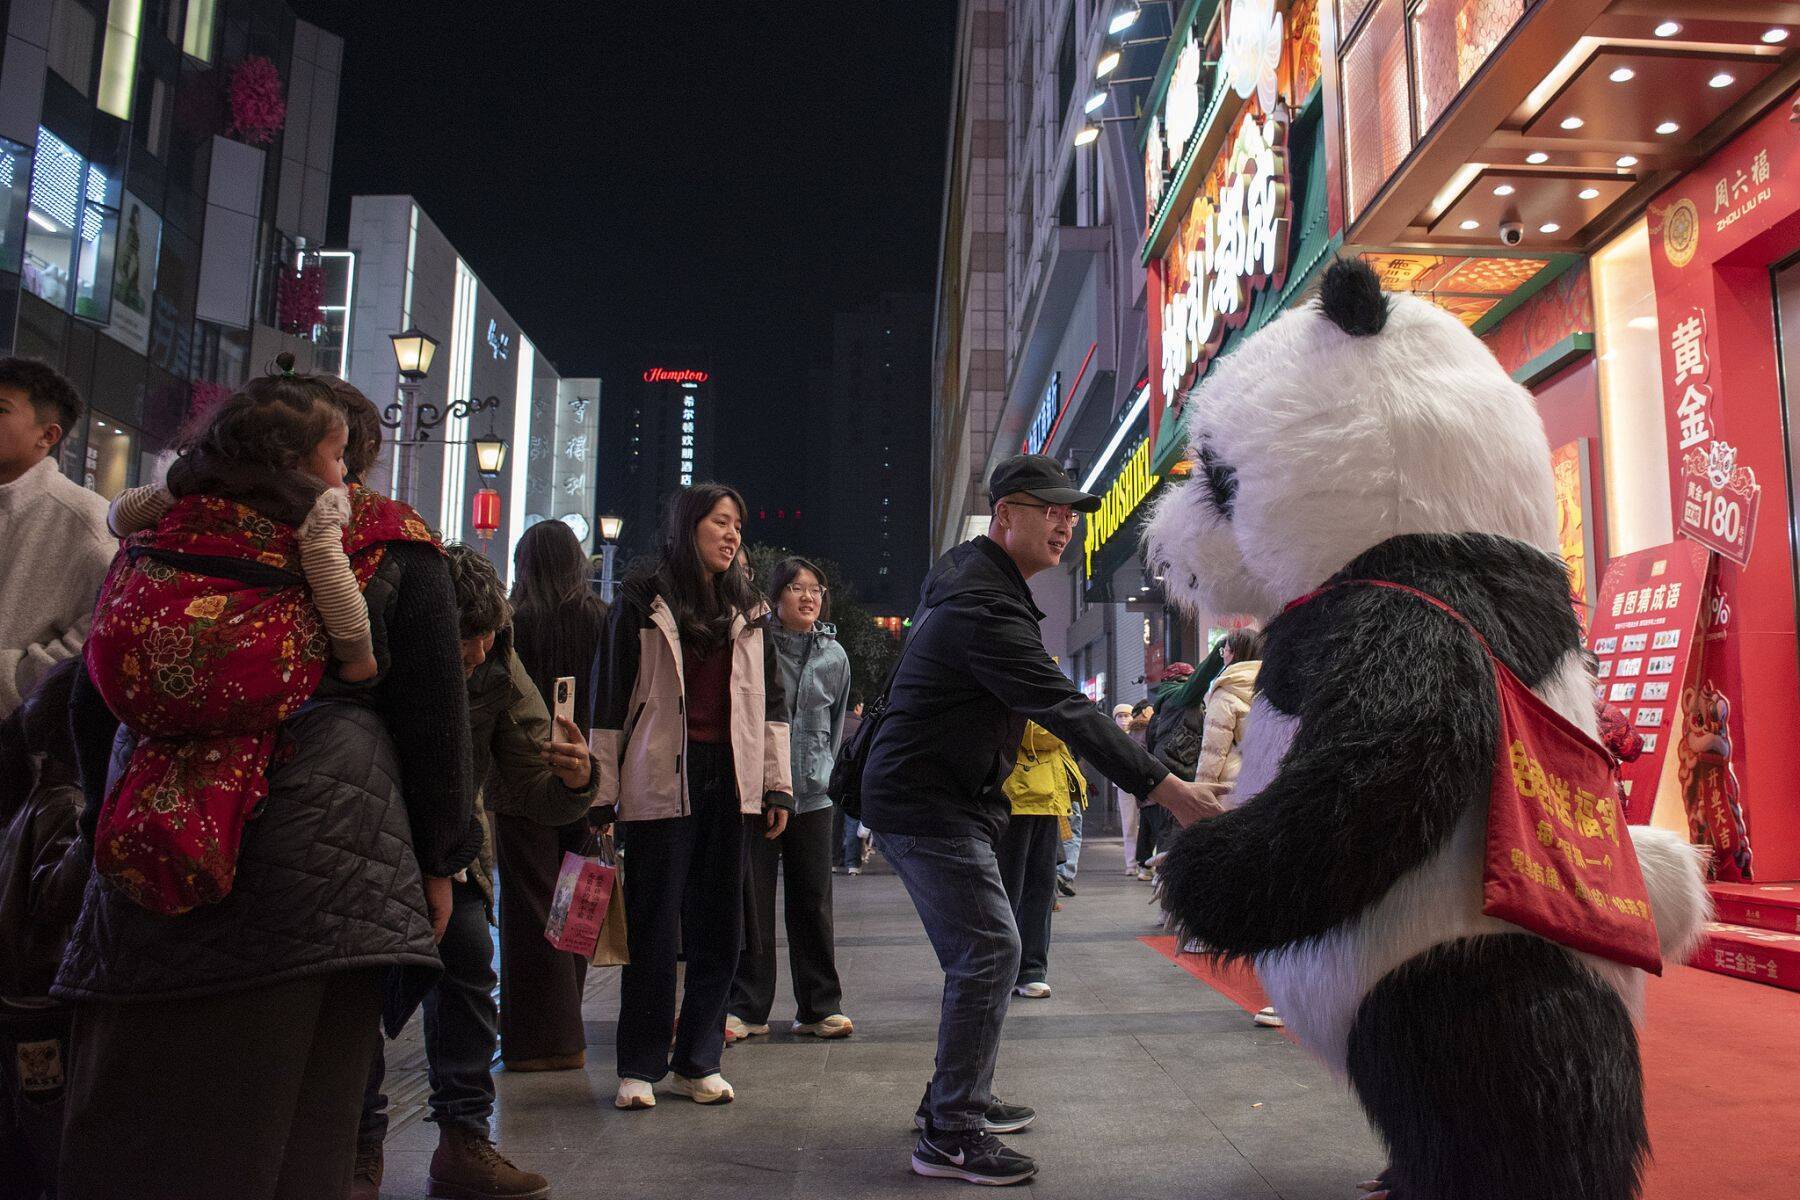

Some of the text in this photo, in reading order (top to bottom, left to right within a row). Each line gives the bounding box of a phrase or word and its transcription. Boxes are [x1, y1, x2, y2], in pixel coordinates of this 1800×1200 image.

[1714, 149, 1770, 214] 周六福
[1715, 187, 1772, 233] ZHOU LIU FU
[644, 367, 708, 382] Hampton
[1672, 316, 1709, 450] 黄金
[681, 395, 695, 487] 希尔顿欢朋酒店
[1687, 481, 1703, 503] 黄金
[1703, 490, 1740, 543] 180
[1611, 583, 1682, 616] 看图猜成语
[1707, 769, 1731, 849] 开业大吉
[1714, 949, 1778, 979] 买三金送一金
